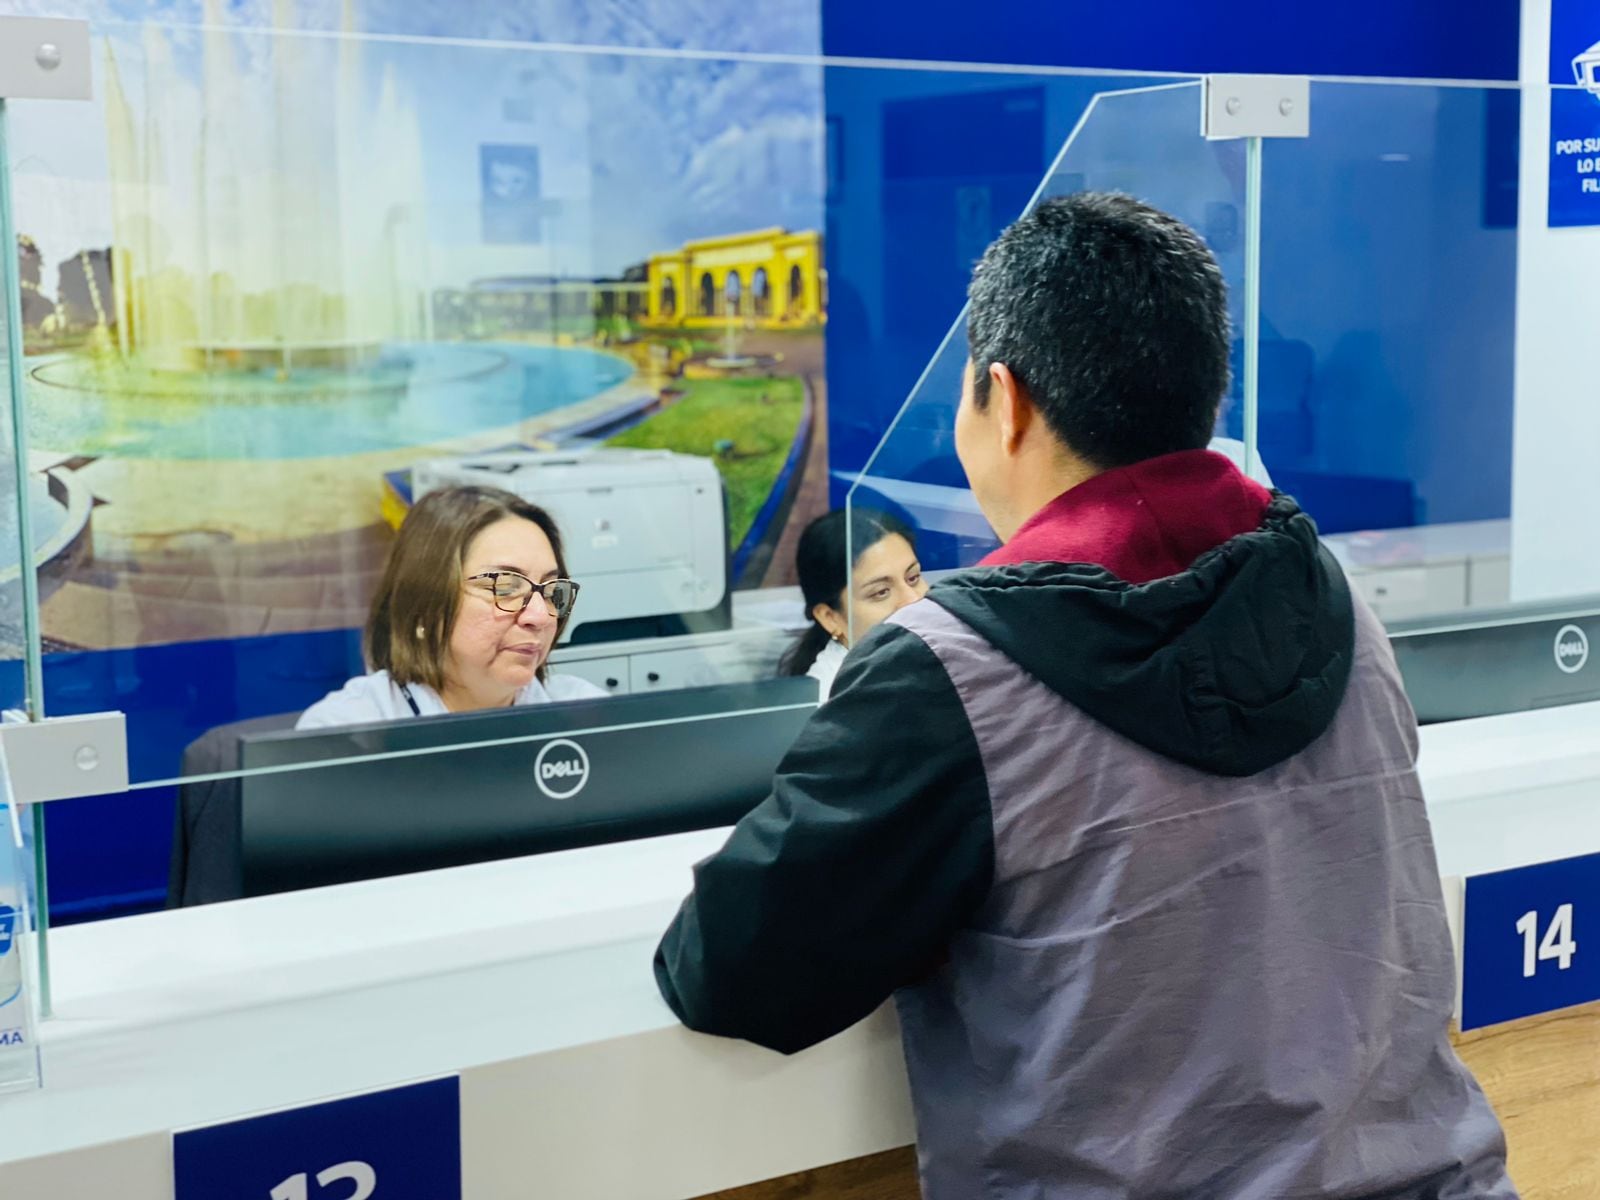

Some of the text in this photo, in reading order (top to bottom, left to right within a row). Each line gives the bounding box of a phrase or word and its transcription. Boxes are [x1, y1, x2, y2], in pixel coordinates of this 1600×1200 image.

[1556, 137, 1600, 155] POR SU
[1577, 158, 1594, 174] LO
[1560, 641, 1584, 658] DELL
[541, 759, 584, 779] DELL
[1516, 903, 1576, 977] 14
